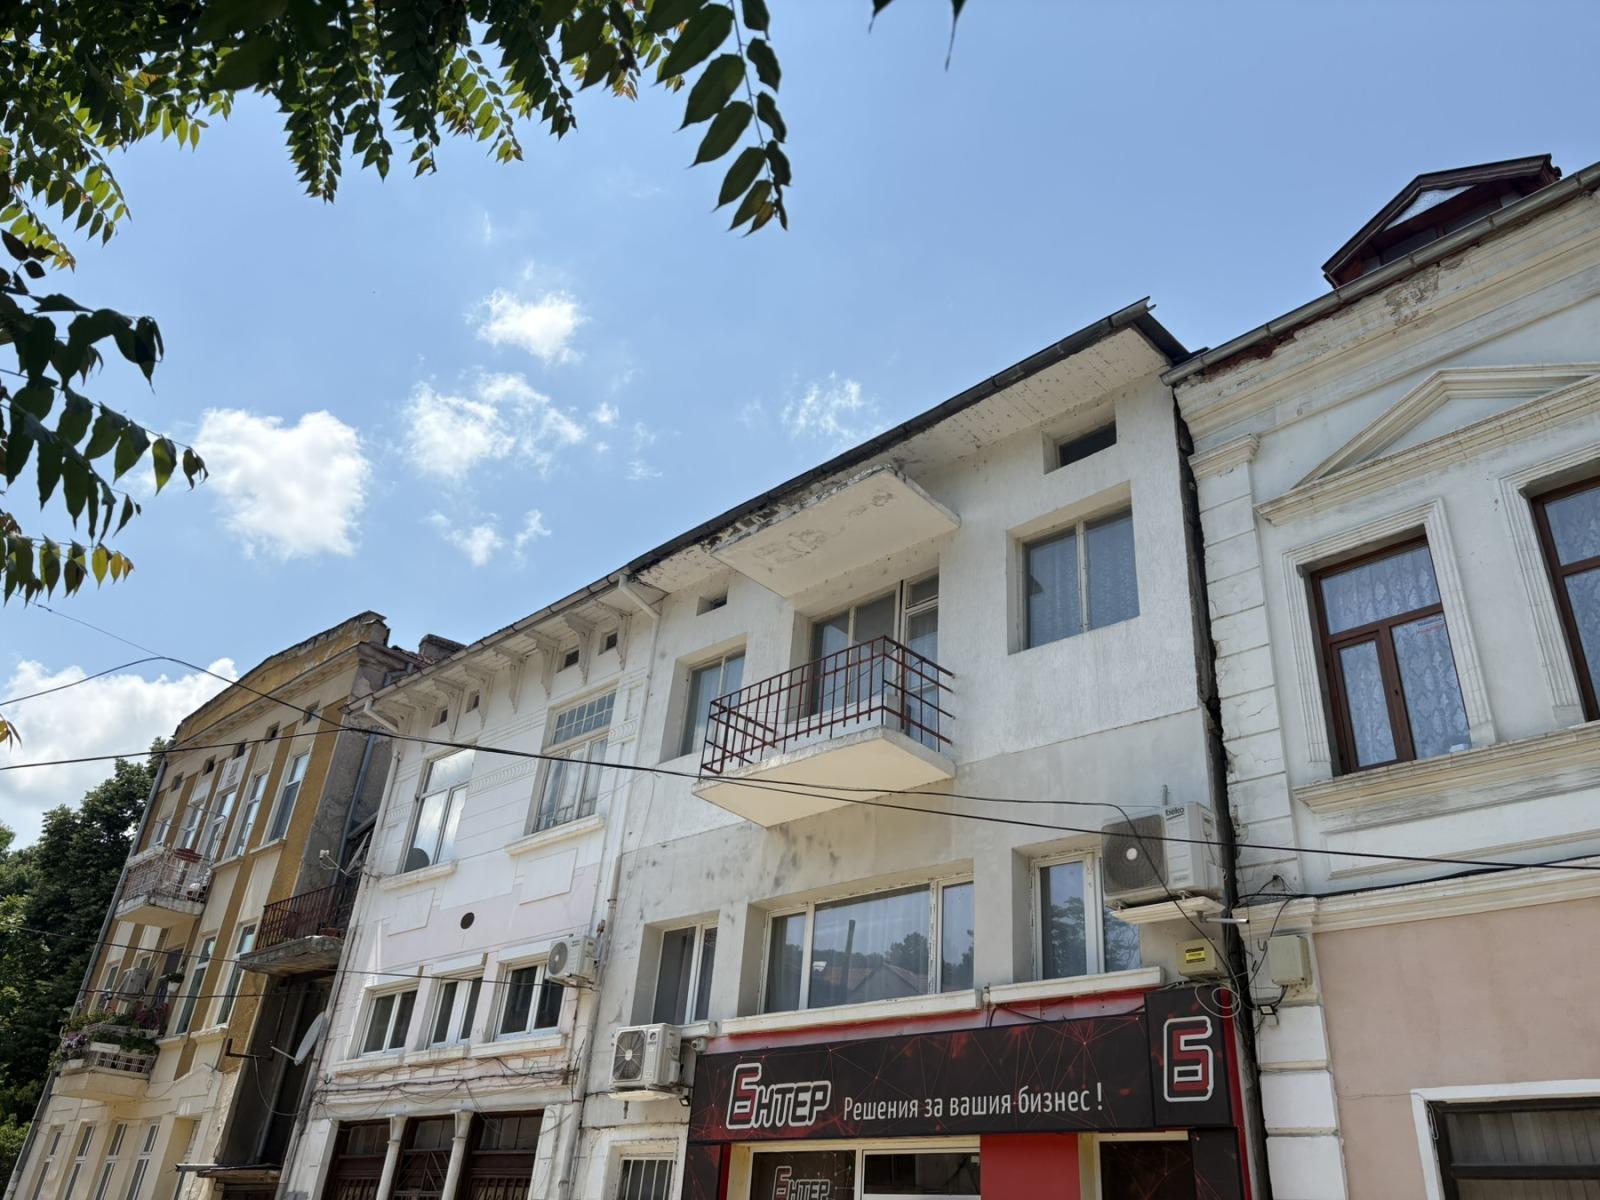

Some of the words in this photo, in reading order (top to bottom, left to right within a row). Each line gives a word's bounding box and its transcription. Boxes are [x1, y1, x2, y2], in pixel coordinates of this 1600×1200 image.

[843, 1096, 919, 1121] Решения
[924, 1098, 943, 1118] за
[949, 1095, 1012, 1117] вашия
